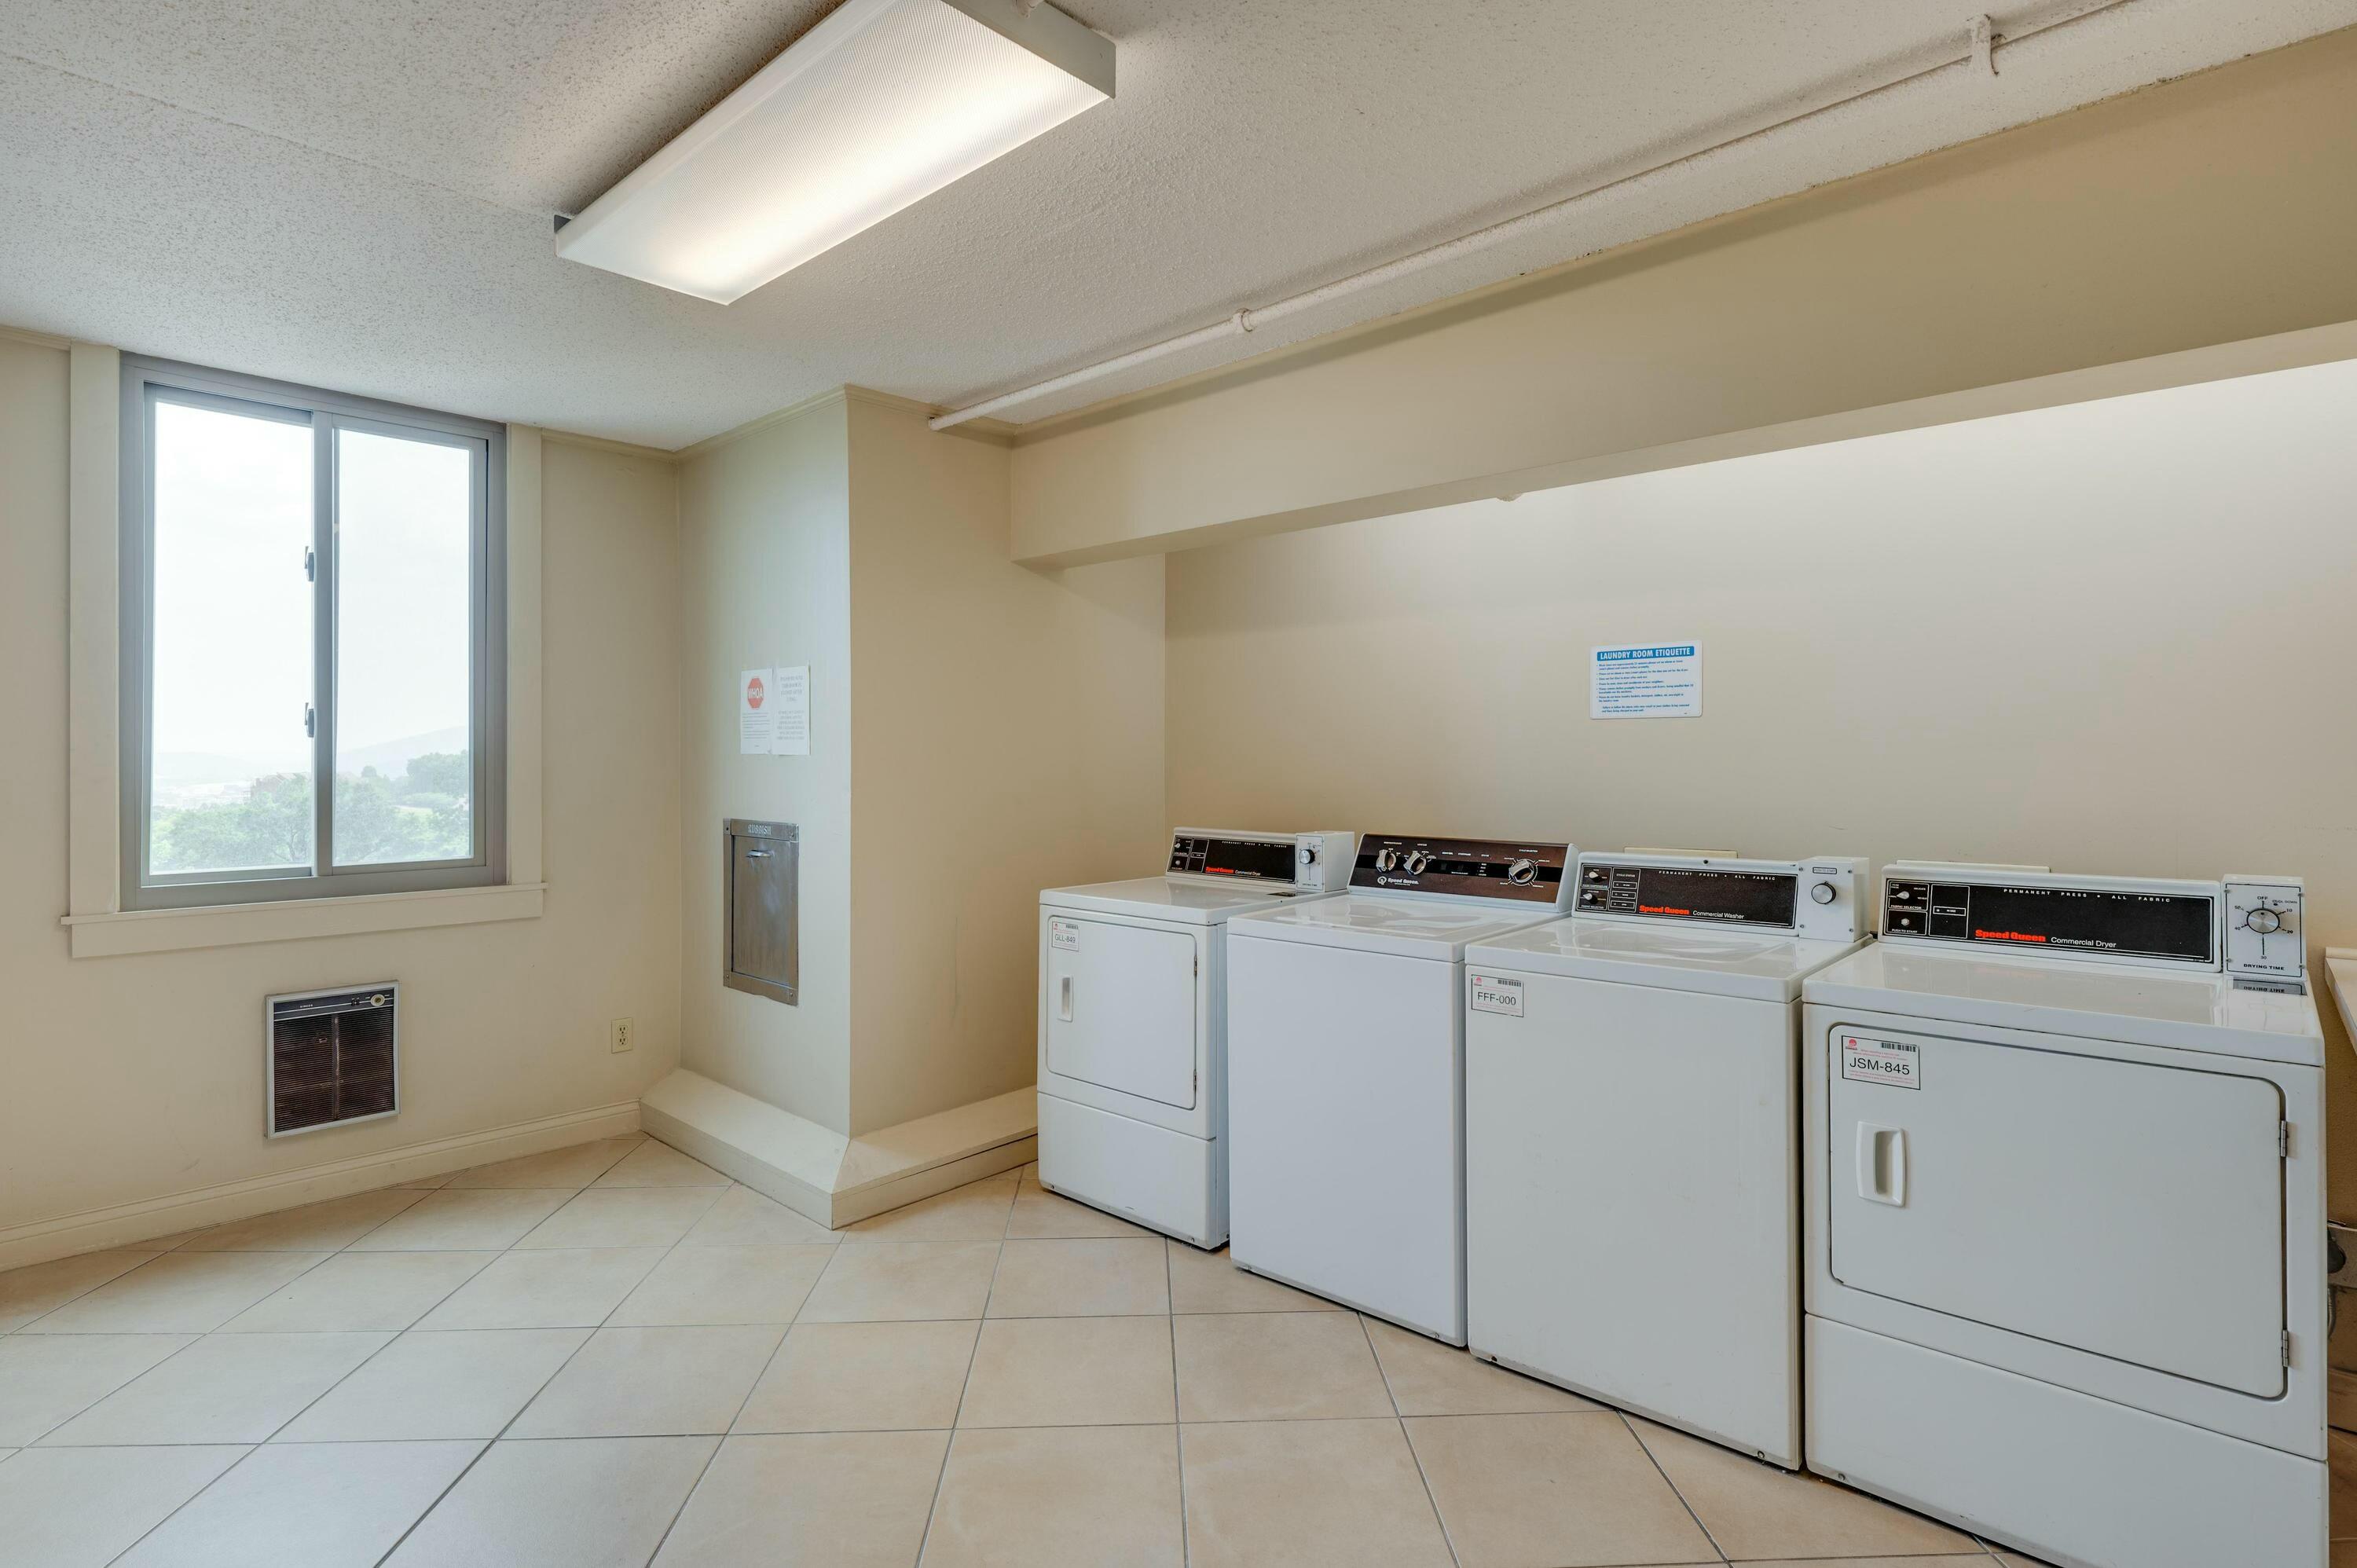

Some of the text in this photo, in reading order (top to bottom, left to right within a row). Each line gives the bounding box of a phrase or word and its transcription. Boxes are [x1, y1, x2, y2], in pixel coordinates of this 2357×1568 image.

[1600, 648, 1690, 659] LAUNDRY ROOM ETIQUETTE
[1639, 905, 1663, 914] Speed
[1664, 907, 1690, 915] Queen
[1975, 929, 2117, 949] Speed Queen Commercial Dryer
[1477, 992, 1516, 1006] FFF-000
[1850, 1057, 1910, 1075] JSM-845
